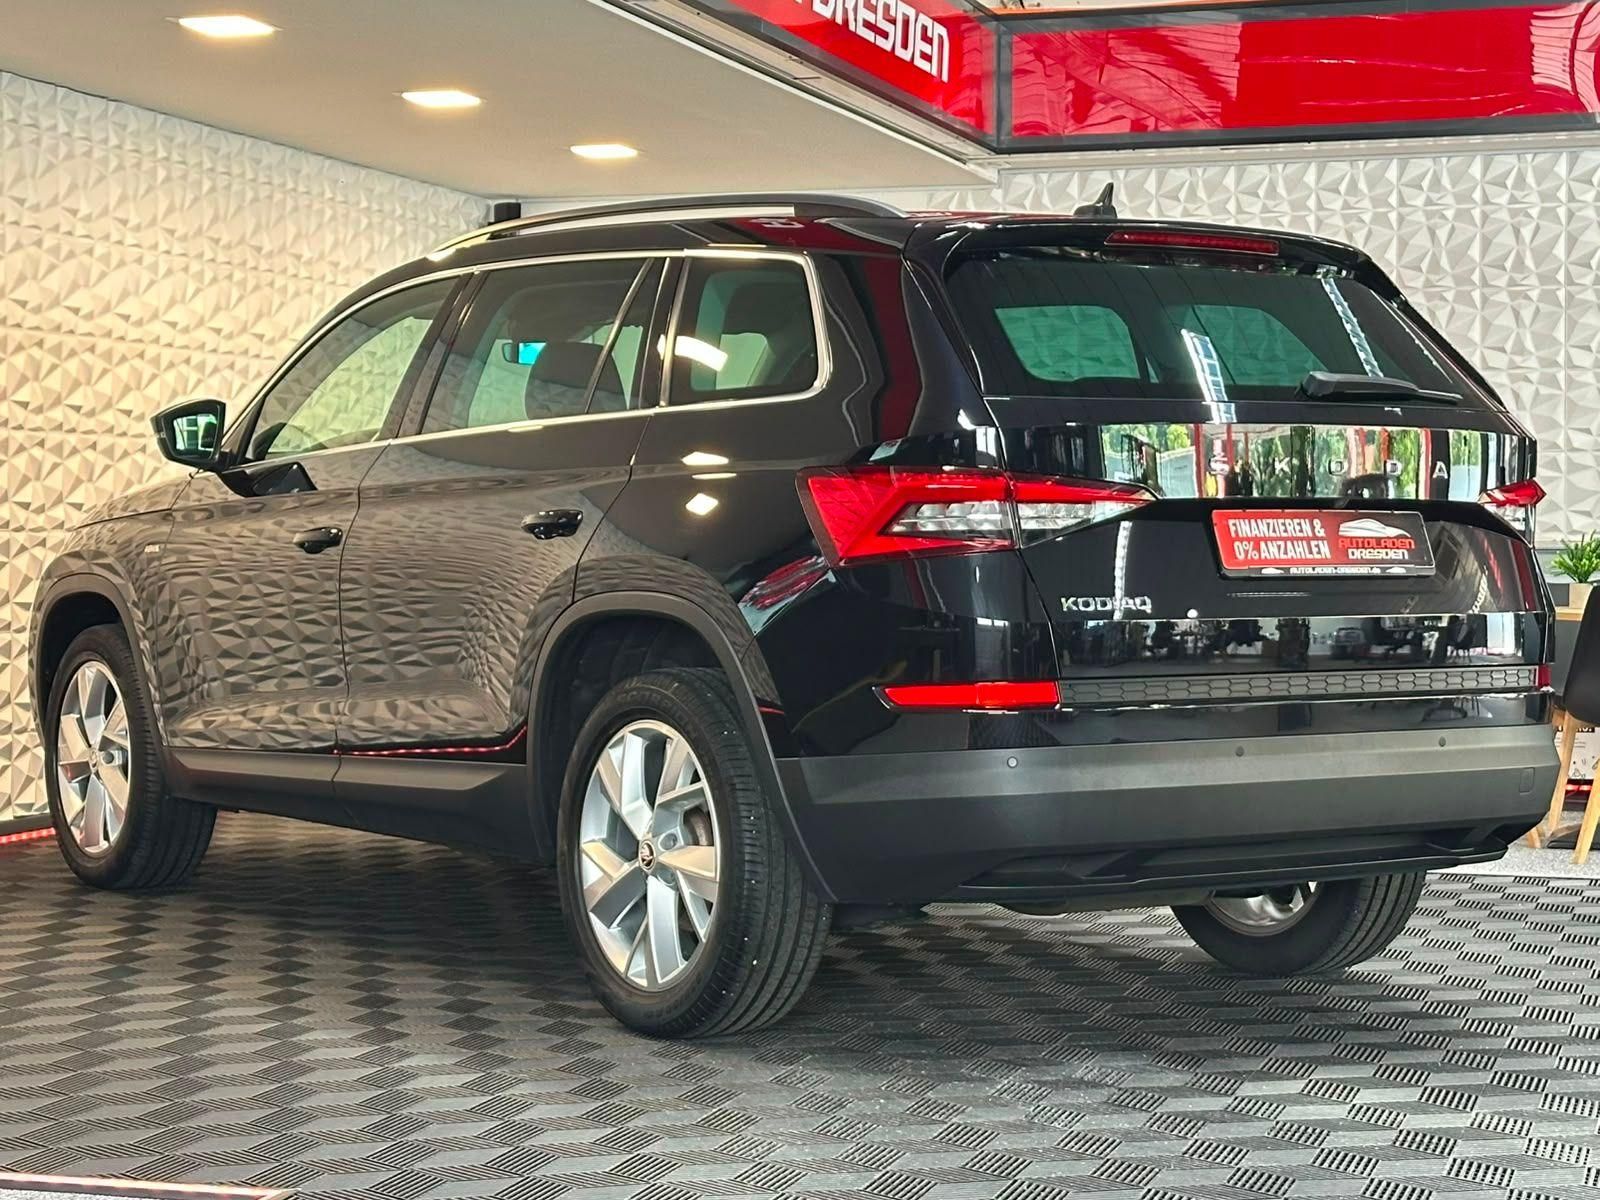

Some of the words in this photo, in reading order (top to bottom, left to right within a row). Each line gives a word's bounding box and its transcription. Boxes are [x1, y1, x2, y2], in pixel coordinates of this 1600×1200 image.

[1228, 518, 1313, 538] FINANZIEREN
[1313, 518, 1326, 537] &
[1233, 541, 1259, 560] 0%
[1260, 540, 1332, 560] ANZAHLEN
[1338, 538, 1415, 550] AUTOLADEN
[1348, 548, 1409, 560] DRESDEN
[1060, 596, 1152, 614] KODIAQ
